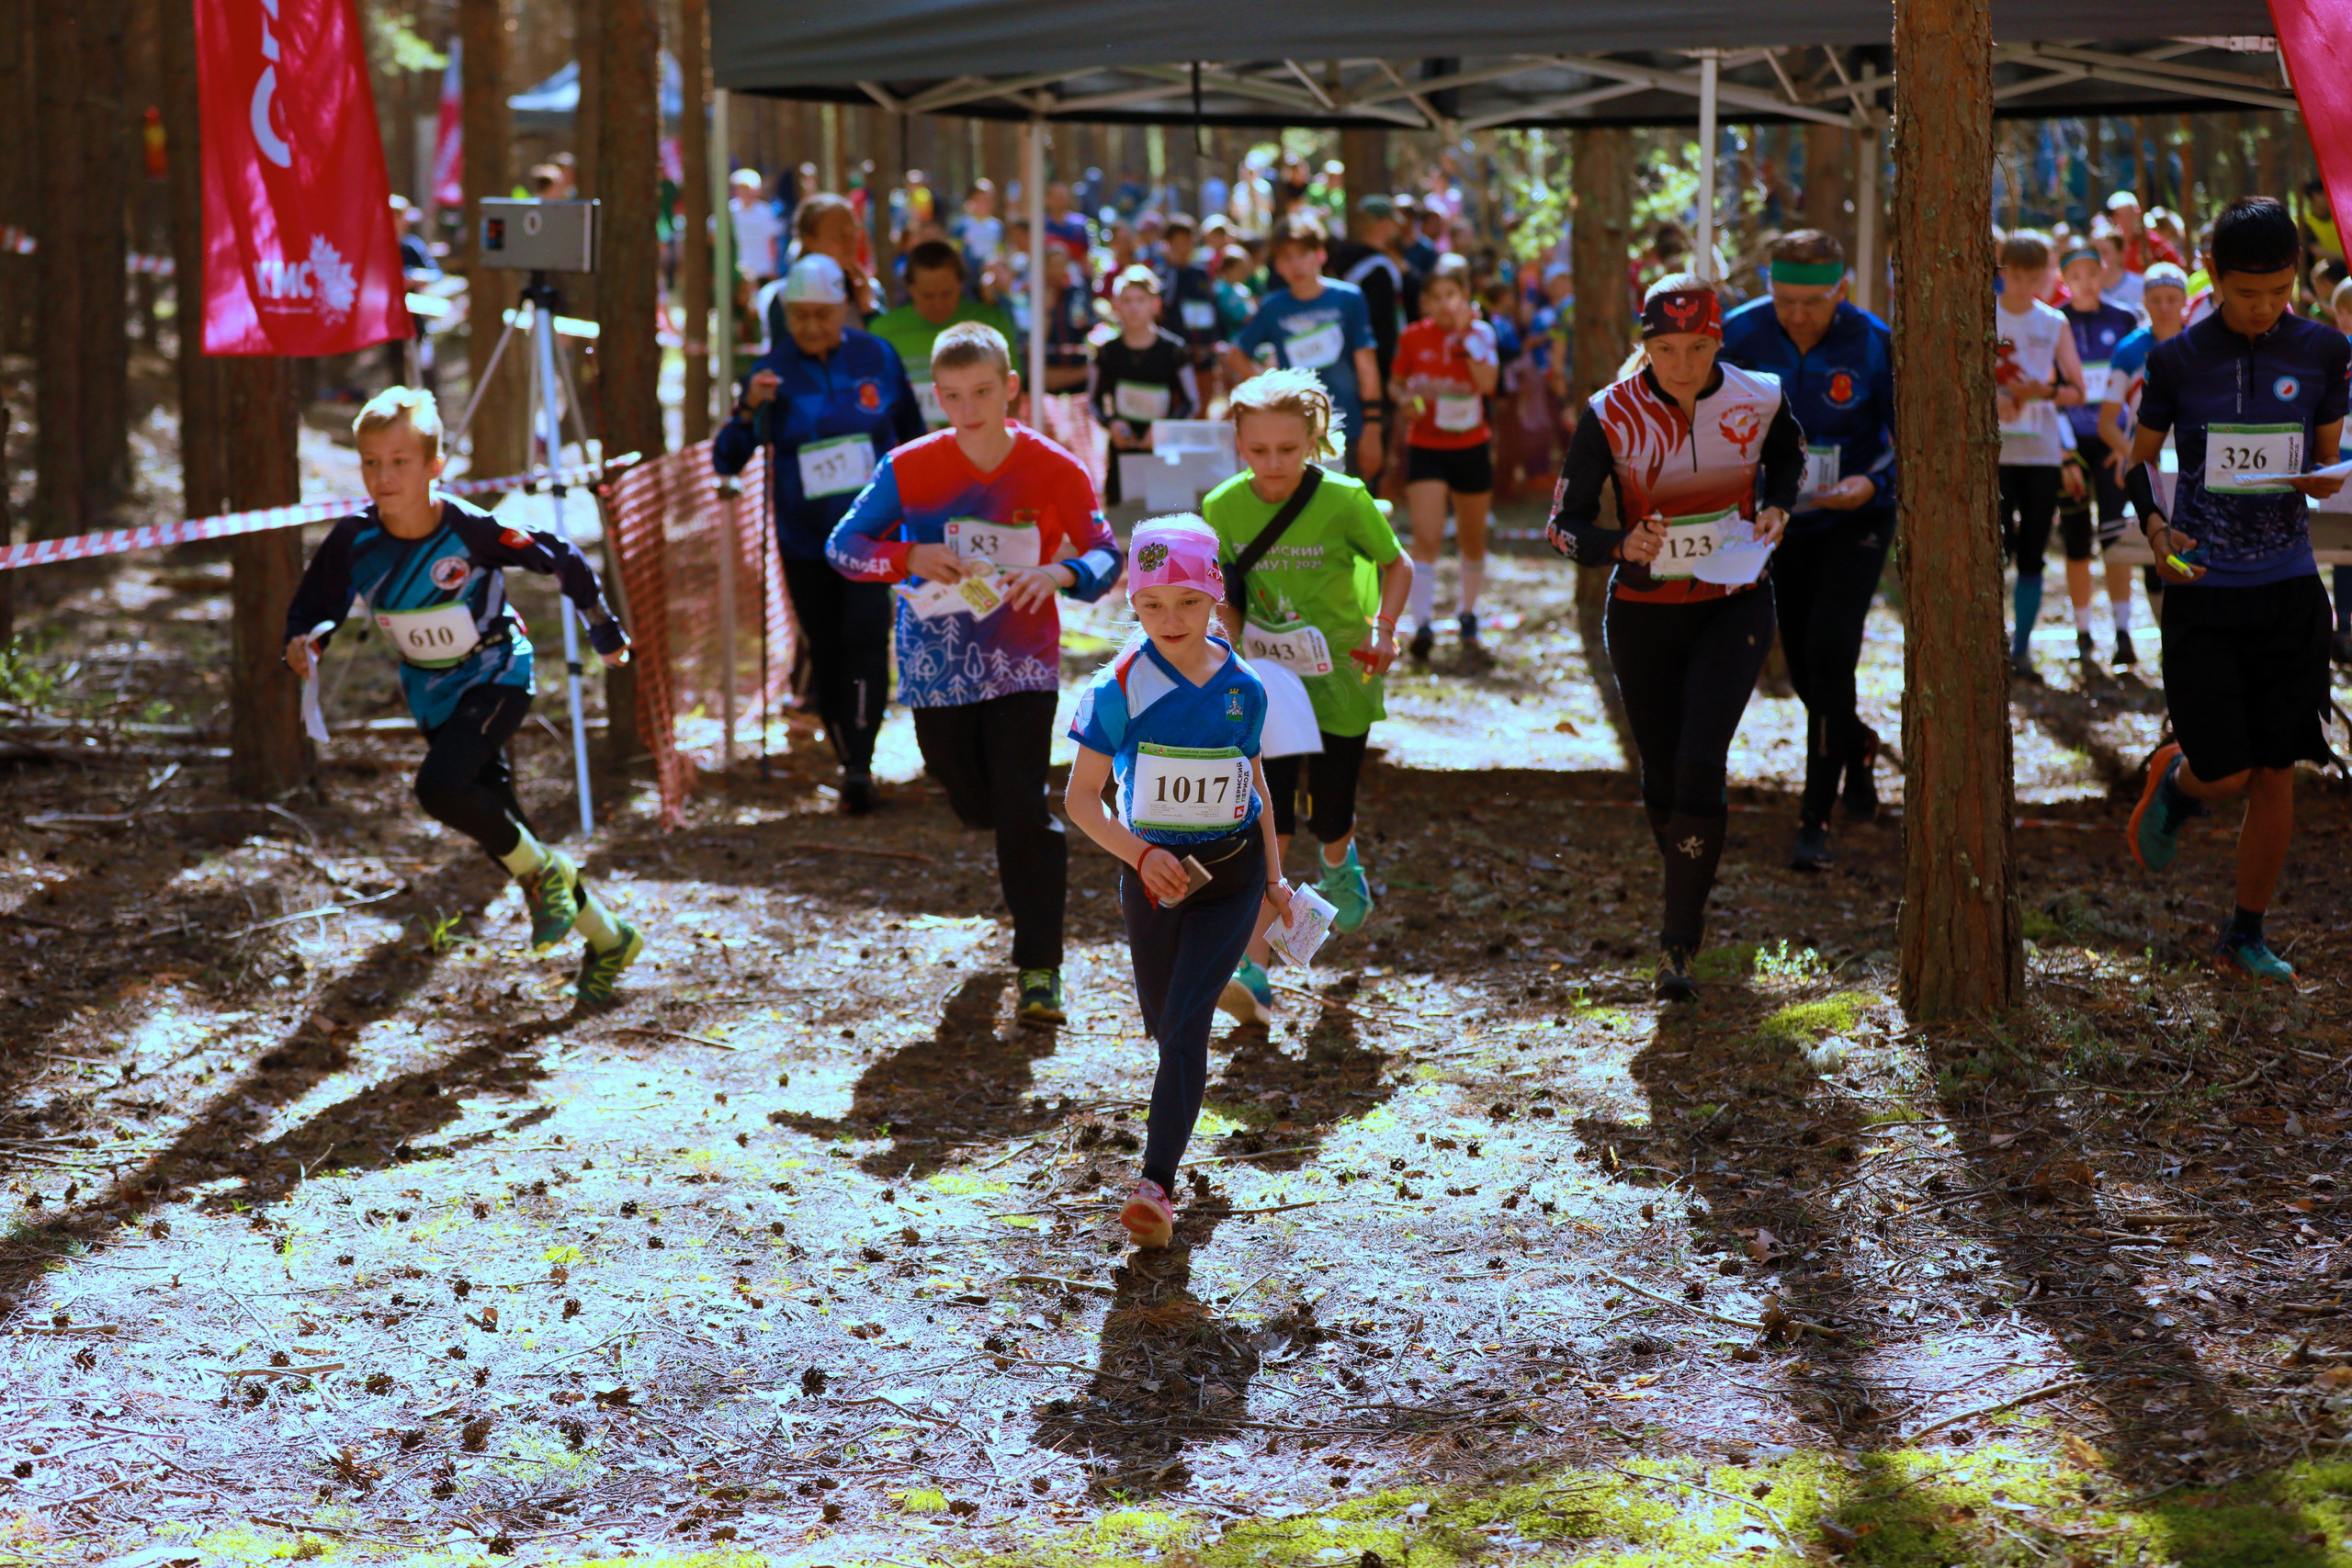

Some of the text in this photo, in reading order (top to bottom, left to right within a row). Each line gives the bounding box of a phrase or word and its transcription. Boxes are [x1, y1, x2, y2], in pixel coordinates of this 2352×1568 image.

[2221, 446, 2267, 470] 326
[970, 535, 999, 557] 83
[1668, 536, 1713, 558] 123
[409, 626, 454, 649] 610
[1254, 639, 1295, 660] 943
[1154, 775, 1230, 804] 1017
[1235, 761, 1243, 804] ПЕРМСКИЙ
[1240, 770, 1250, 803] ПЕРИОД
